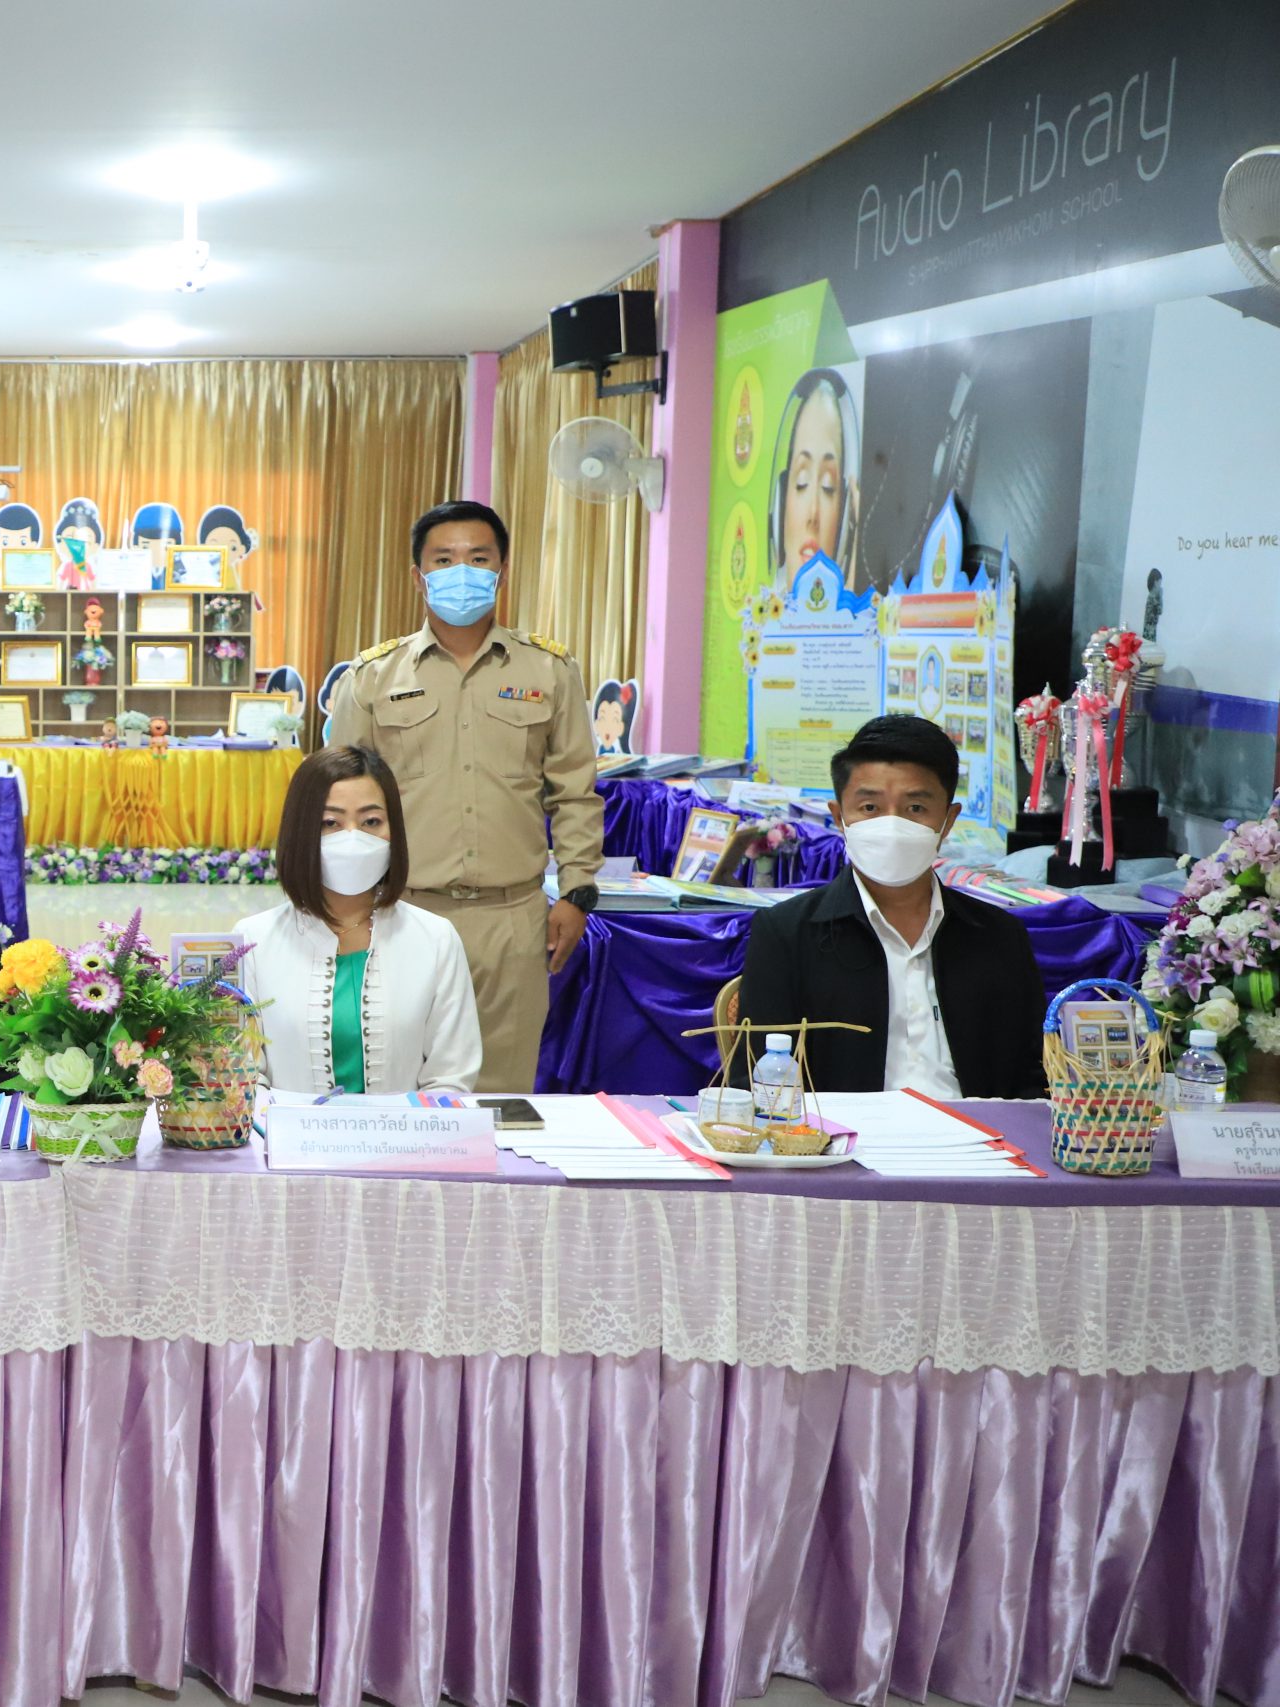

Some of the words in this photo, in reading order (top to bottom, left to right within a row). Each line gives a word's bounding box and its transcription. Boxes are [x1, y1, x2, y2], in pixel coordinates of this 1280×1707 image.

[854, 151, 963, 270] Audio
[982, 57, 1177, 213] Library
[1061, 180, 1123, 225] SCHOOL
[1178, 536, 1192, 551] Do
[1197, 538, 1219, 560] you
[1225, 531, 1253, 548] hear
[1259, 534, 1279, 546] me
[300, 1114, 408, 1132] นางสาวลาวัลย์
[414, 1115, 460, 1132] เกติมา
